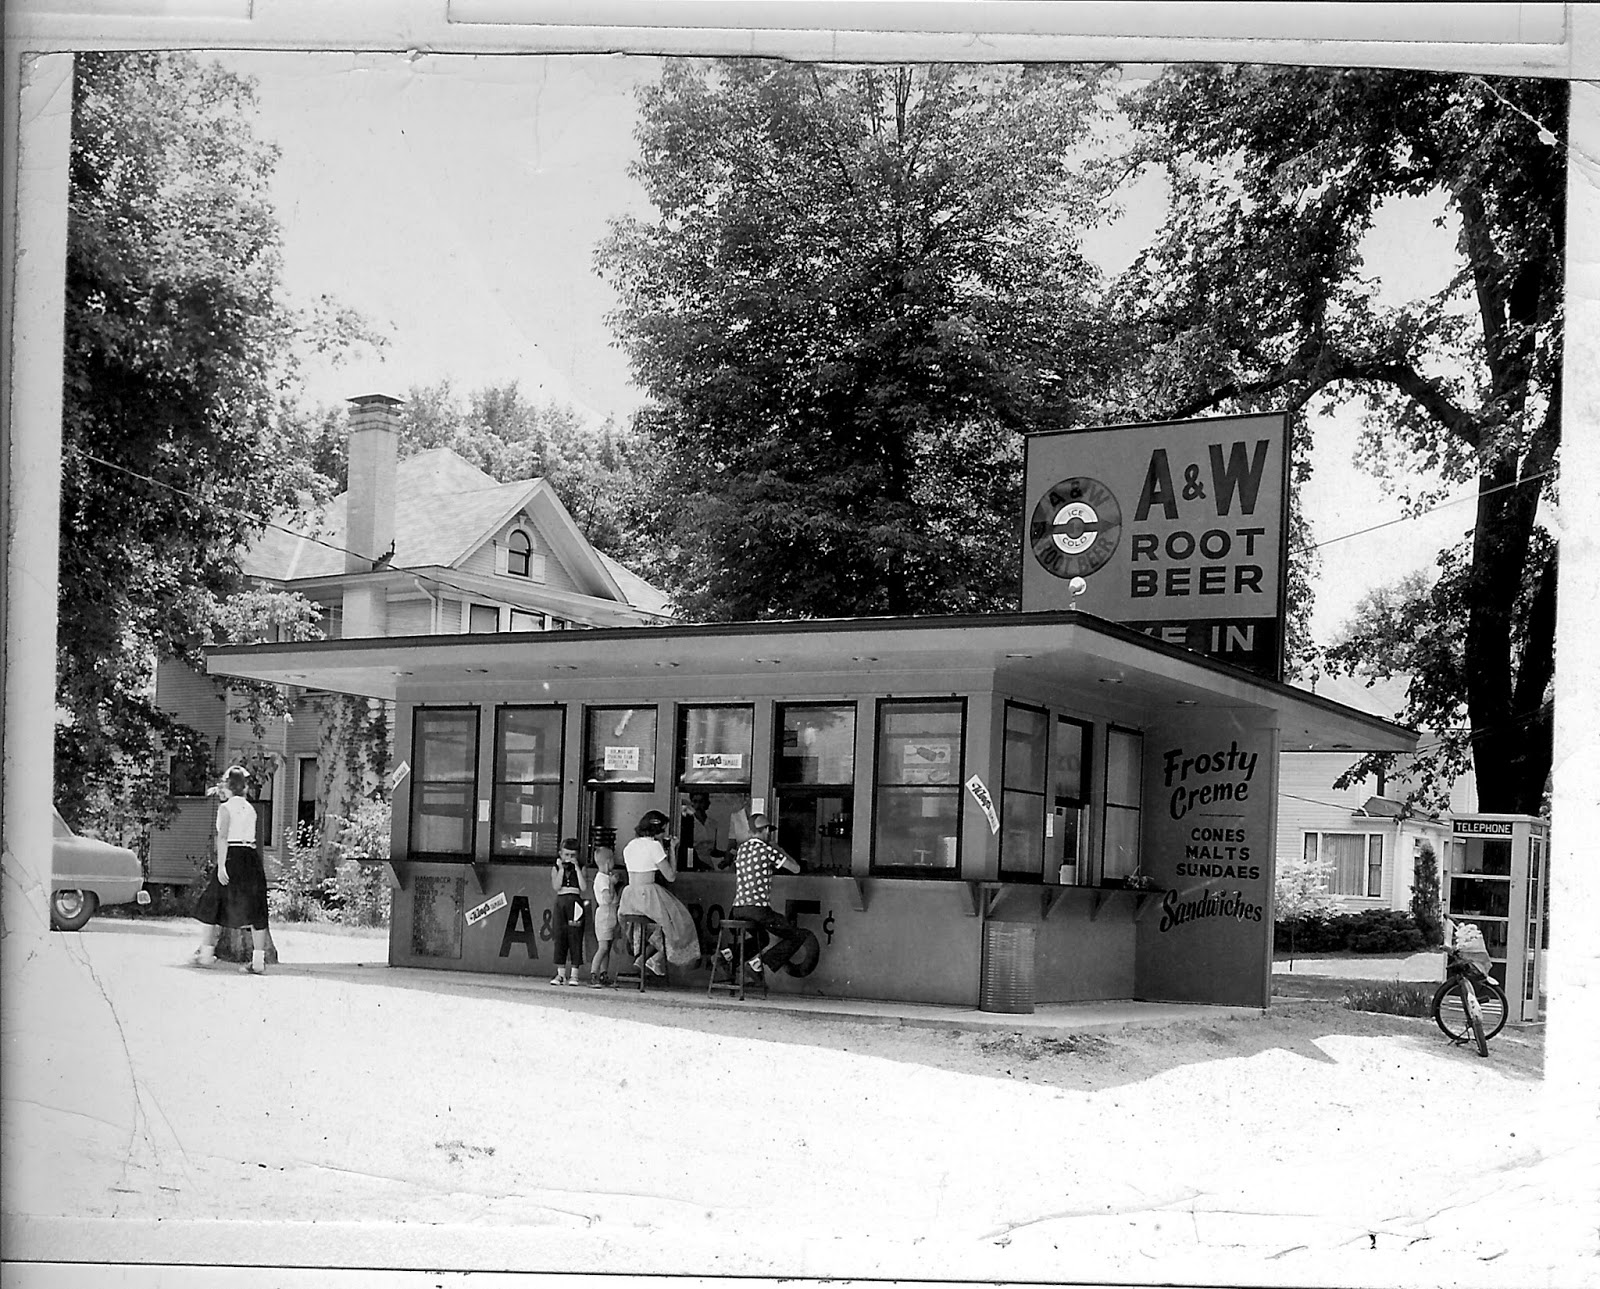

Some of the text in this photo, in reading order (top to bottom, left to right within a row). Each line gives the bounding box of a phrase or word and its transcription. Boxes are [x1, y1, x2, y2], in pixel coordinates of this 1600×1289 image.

[1134, 440, 1270, 521] A&W
[1068, 509, 1084, 518] ICE
[1062, 535, 1089, 548] COLD
[1131, 528, 1265, 562] ROOT
[1131, 565, 1263, 598] BEER
[1210, 625, 1255, 652] IN
[1163, 740, 1258, 787] Frosty
[1170, 782, 1249, 820] Creme
[1191, 827, 1245, 843] CONES
[1456, 822, 1511, 833] TELEPHONE
[1185, 845, 1250, 861] MALTS
[1175, 863, 1260, 880] SUNDAES
[1159, 888, 1263, 933] Sandwiches
